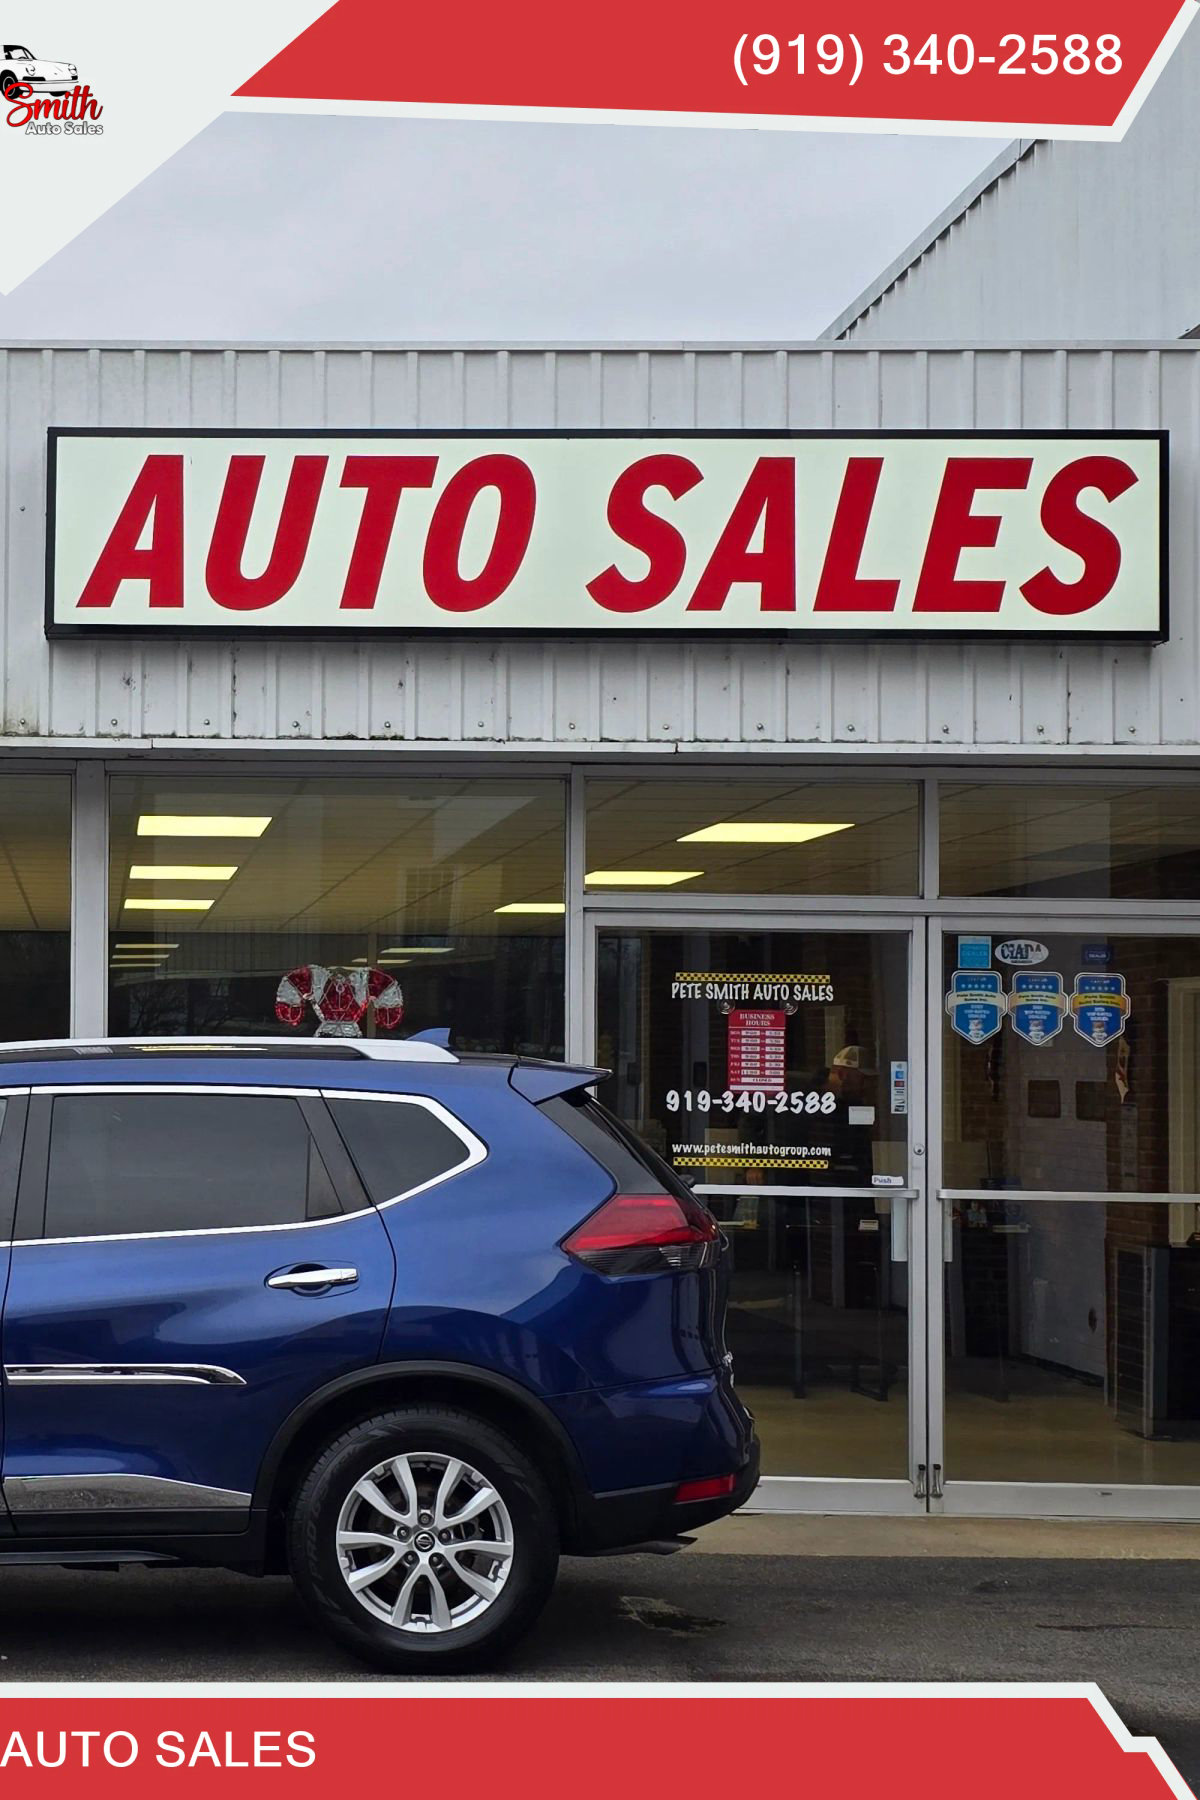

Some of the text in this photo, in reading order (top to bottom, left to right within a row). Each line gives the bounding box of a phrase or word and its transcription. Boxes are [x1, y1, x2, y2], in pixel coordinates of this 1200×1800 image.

[77, 453, 1140, 616] AUTO SALES
[671, 982, 834, 1002] PETE SMITH AUTO SALES
[666, 1090, 837, 1114] 919-340-2588
[671, 1142, 832, 1158] www.petesmithautogroup.com
